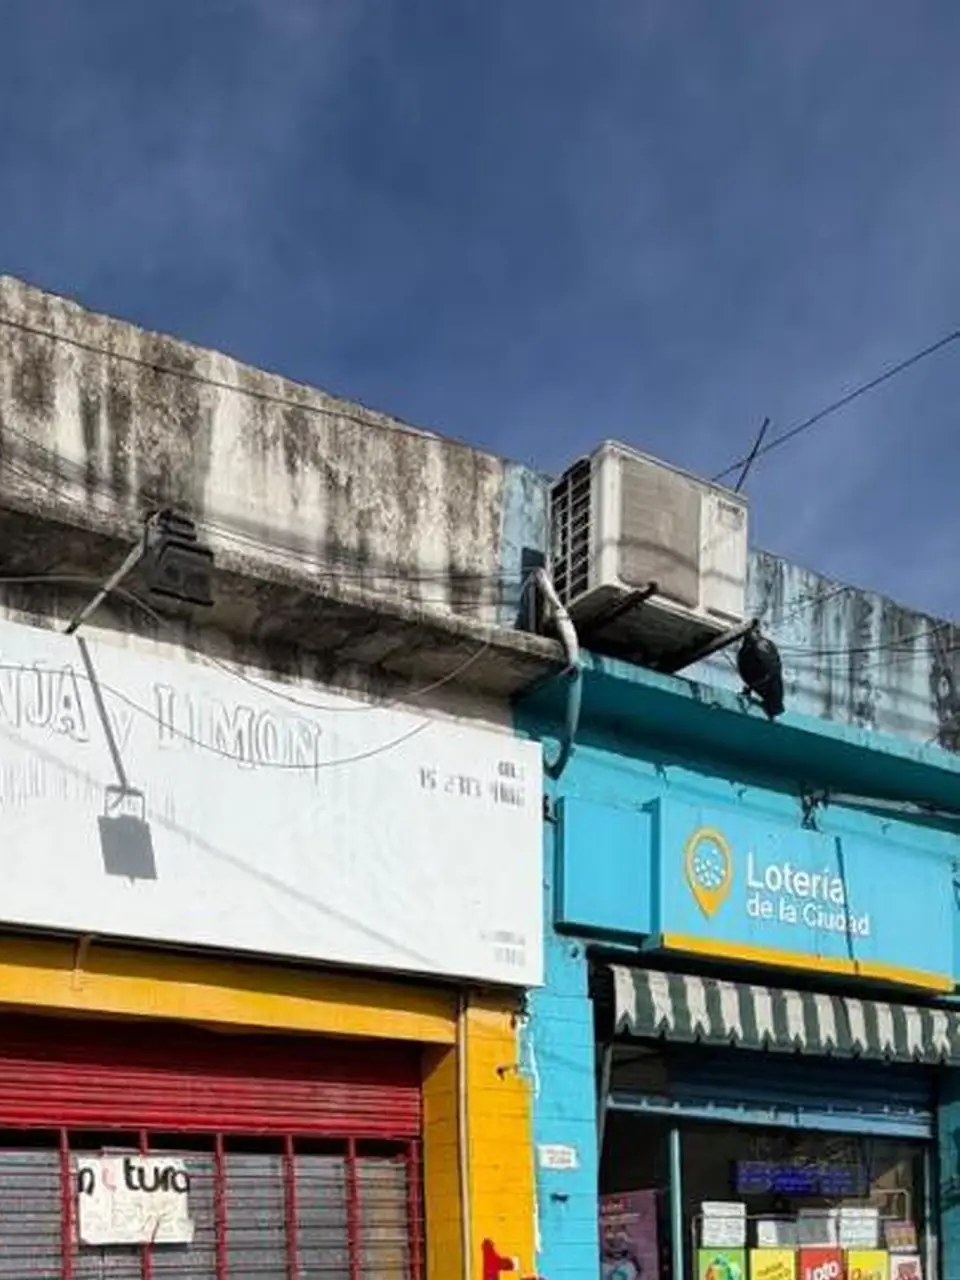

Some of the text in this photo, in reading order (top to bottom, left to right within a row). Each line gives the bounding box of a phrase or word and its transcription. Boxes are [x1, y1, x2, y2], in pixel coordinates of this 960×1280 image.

[746, 891, 870, 936] de la Ciudad
